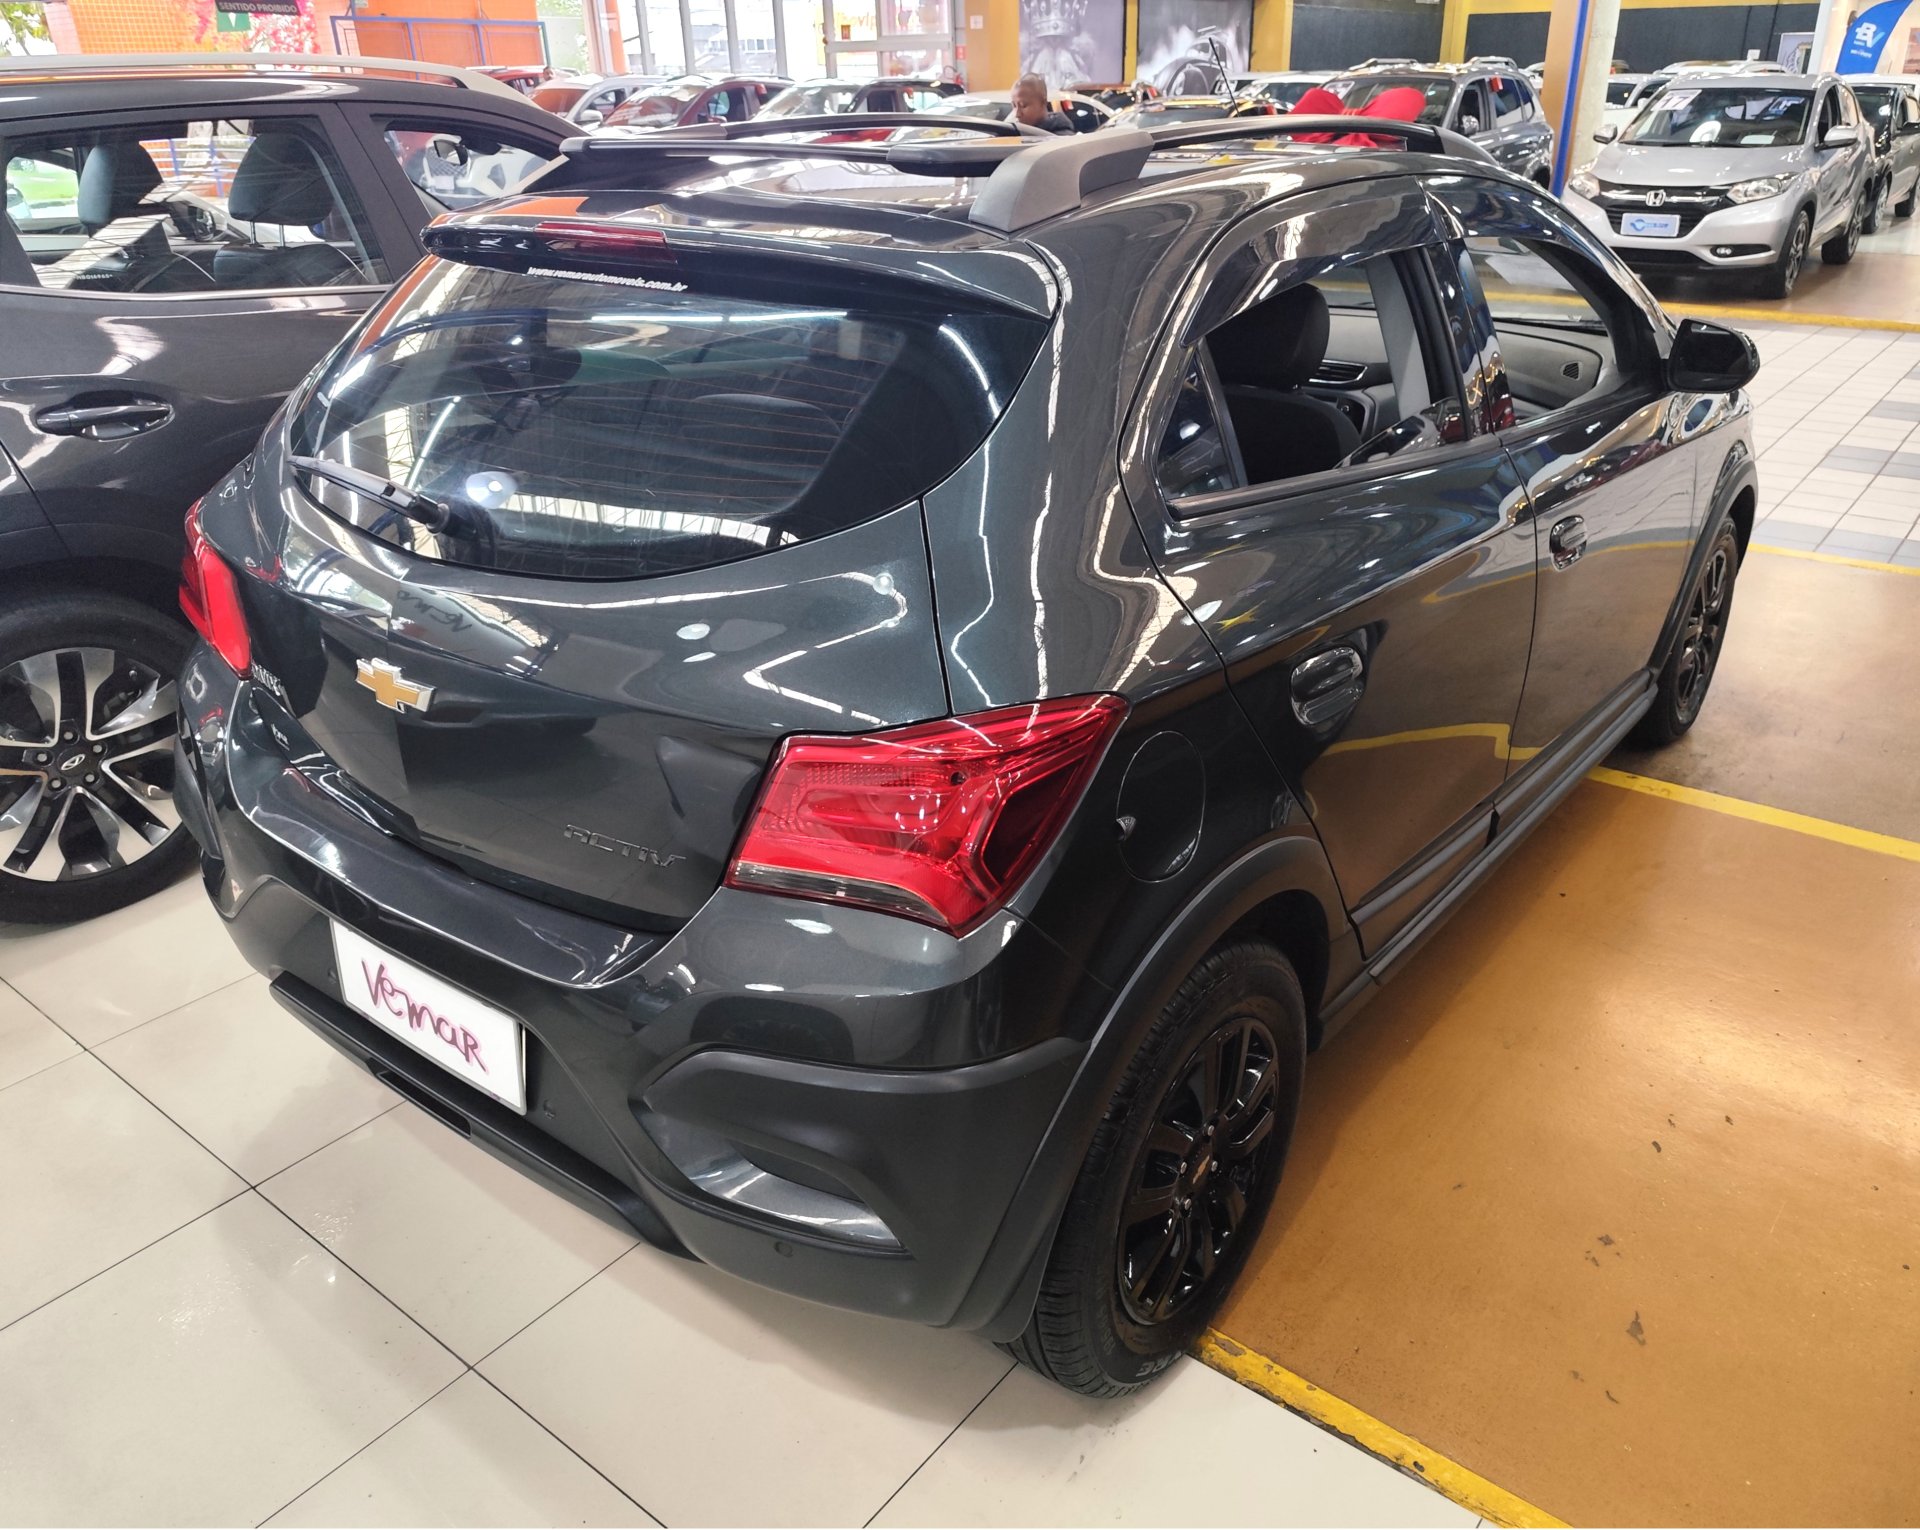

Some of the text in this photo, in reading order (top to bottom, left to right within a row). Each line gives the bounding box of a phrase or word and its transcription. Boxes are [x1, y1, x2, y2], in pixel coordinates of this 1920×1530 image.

[220, 3, 297, 13] SENTIDO PROIBIDO
[564, 824, 687, 868] ACTIV
